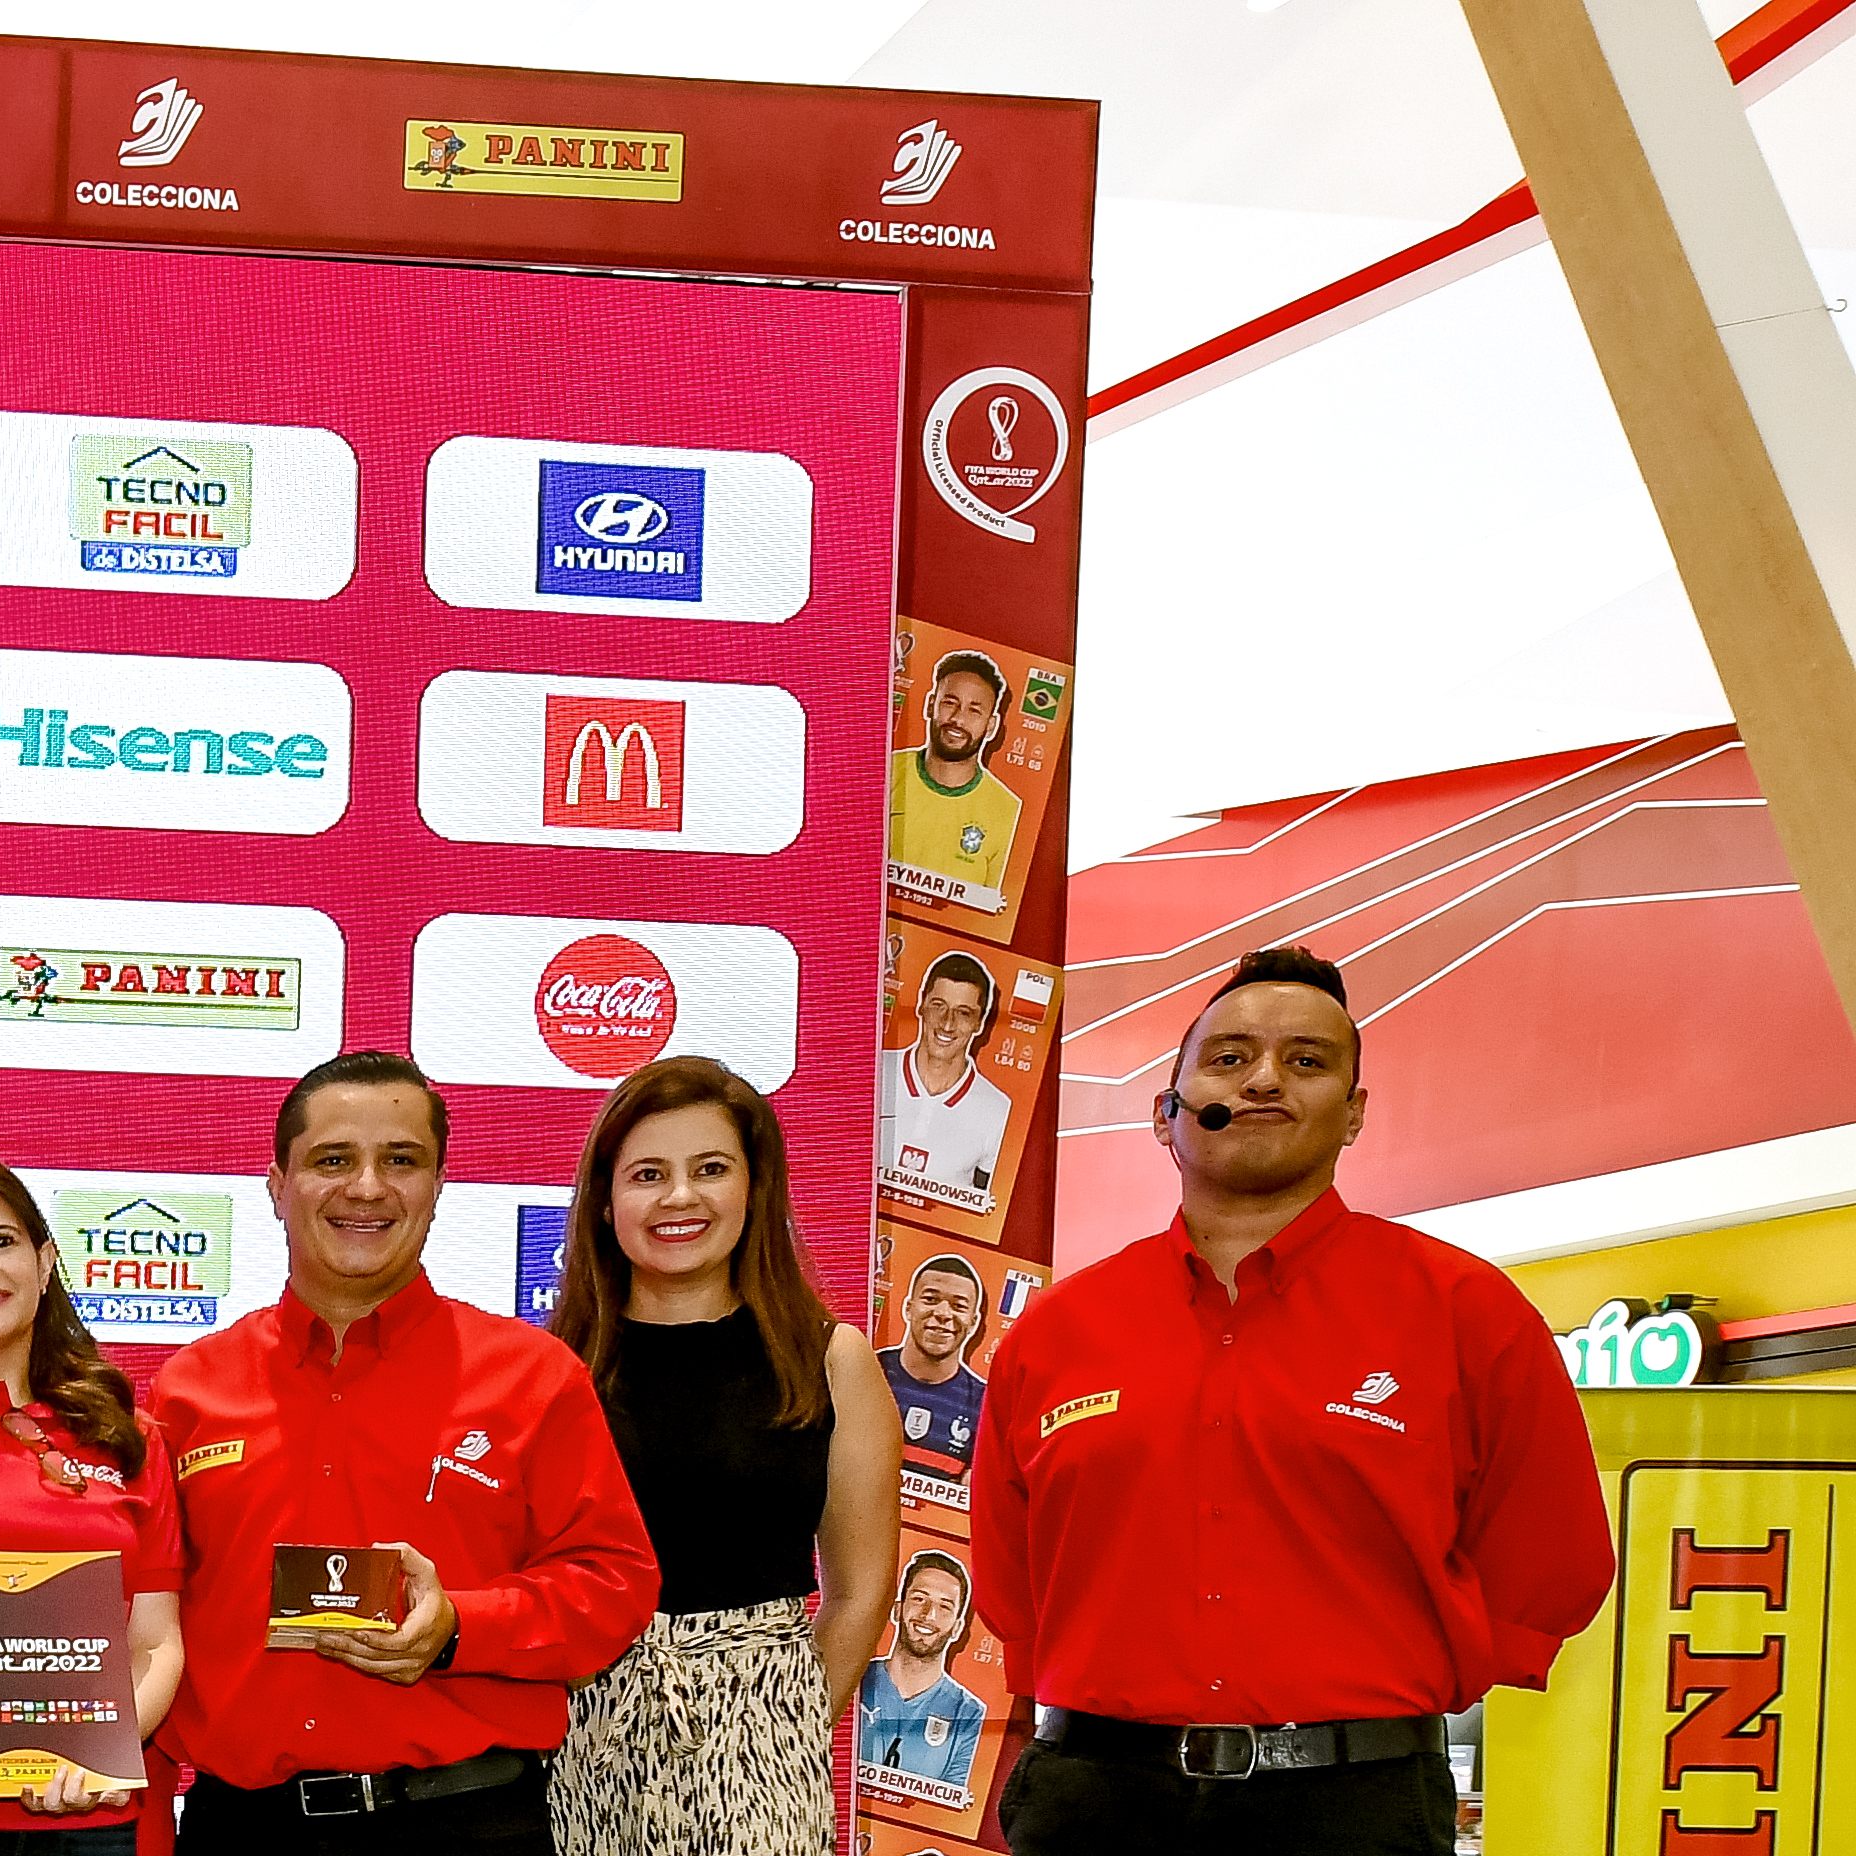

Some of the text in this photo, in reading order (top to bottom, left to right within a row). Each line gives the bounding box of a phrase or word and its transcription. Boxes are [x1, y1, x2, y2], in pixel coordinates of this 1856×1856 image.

[483, 133, 672, 175] PANINI
[75, 179, 240, 213] COLECCIONA
[838, 218, 996, 253] COLECCIONA
[931, 419, 1005, 528] Official Licensed Product
[1019, 468, 1039, 477] CUP
[97, 475, 227, 507] TECNO
[104, 509, 224, 542] FACIL
[124, 545, 226, 575] DISTELSA
[553, 545, 684, 576] HYUNDAI
[1036, 670, 1058, 683] BRA
[1021, 718, 1047, 732] 2010
[887, 863, 967, 900] EYMAR JR
[80, 963, 286, 1000] PANINI
[1026, 971, 1046, 985] POL
[883, 1167, 984, 1208] LEWANDOWSKI
[76, 1228, 207, 1256] TECNO
[85, 1259, 204, 1290] FACIL
[1015, 1271, 1034, 1285] FRA
[102, 1298, 205, 1322] DISTELSA
[1057, 1393, 1114, 1419] PANINI
[1326, 1402, 1407, 1433] COLECCIONA
[188, 1443, 239, 1464] PANINI
[440, 1456, 500, 1490] OLECCIONA
[2, 1638, 71, 1653] WORLD
[72, 1638, 110, 1653] CUP
[878, 1772, 963, 1804] BENTANCUR
